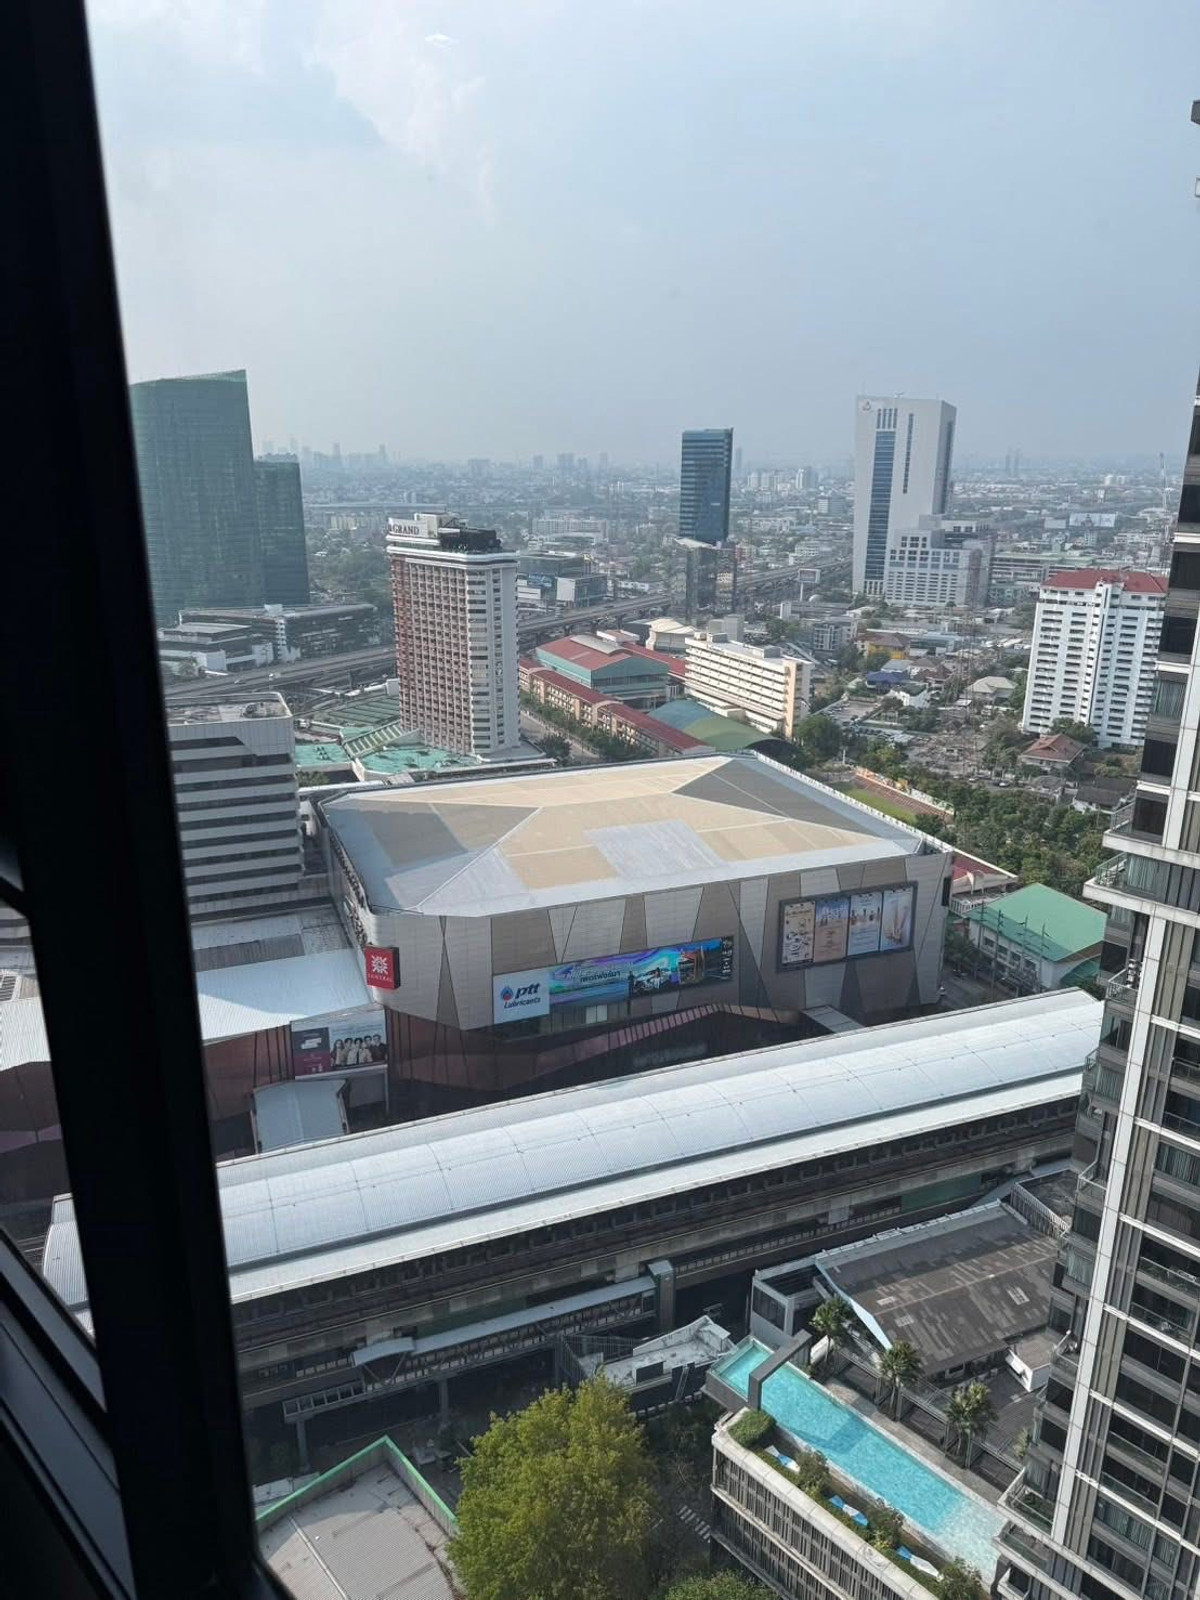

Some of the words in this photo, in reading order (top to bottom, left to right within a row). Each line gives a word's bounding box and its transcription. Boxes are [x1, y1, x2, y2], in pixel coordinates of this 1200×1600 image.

[393, 524, 420, 535] GRAND
[514, 983, 541, 1000] ptt
[503, 997, 541, 1009] Lubricants
